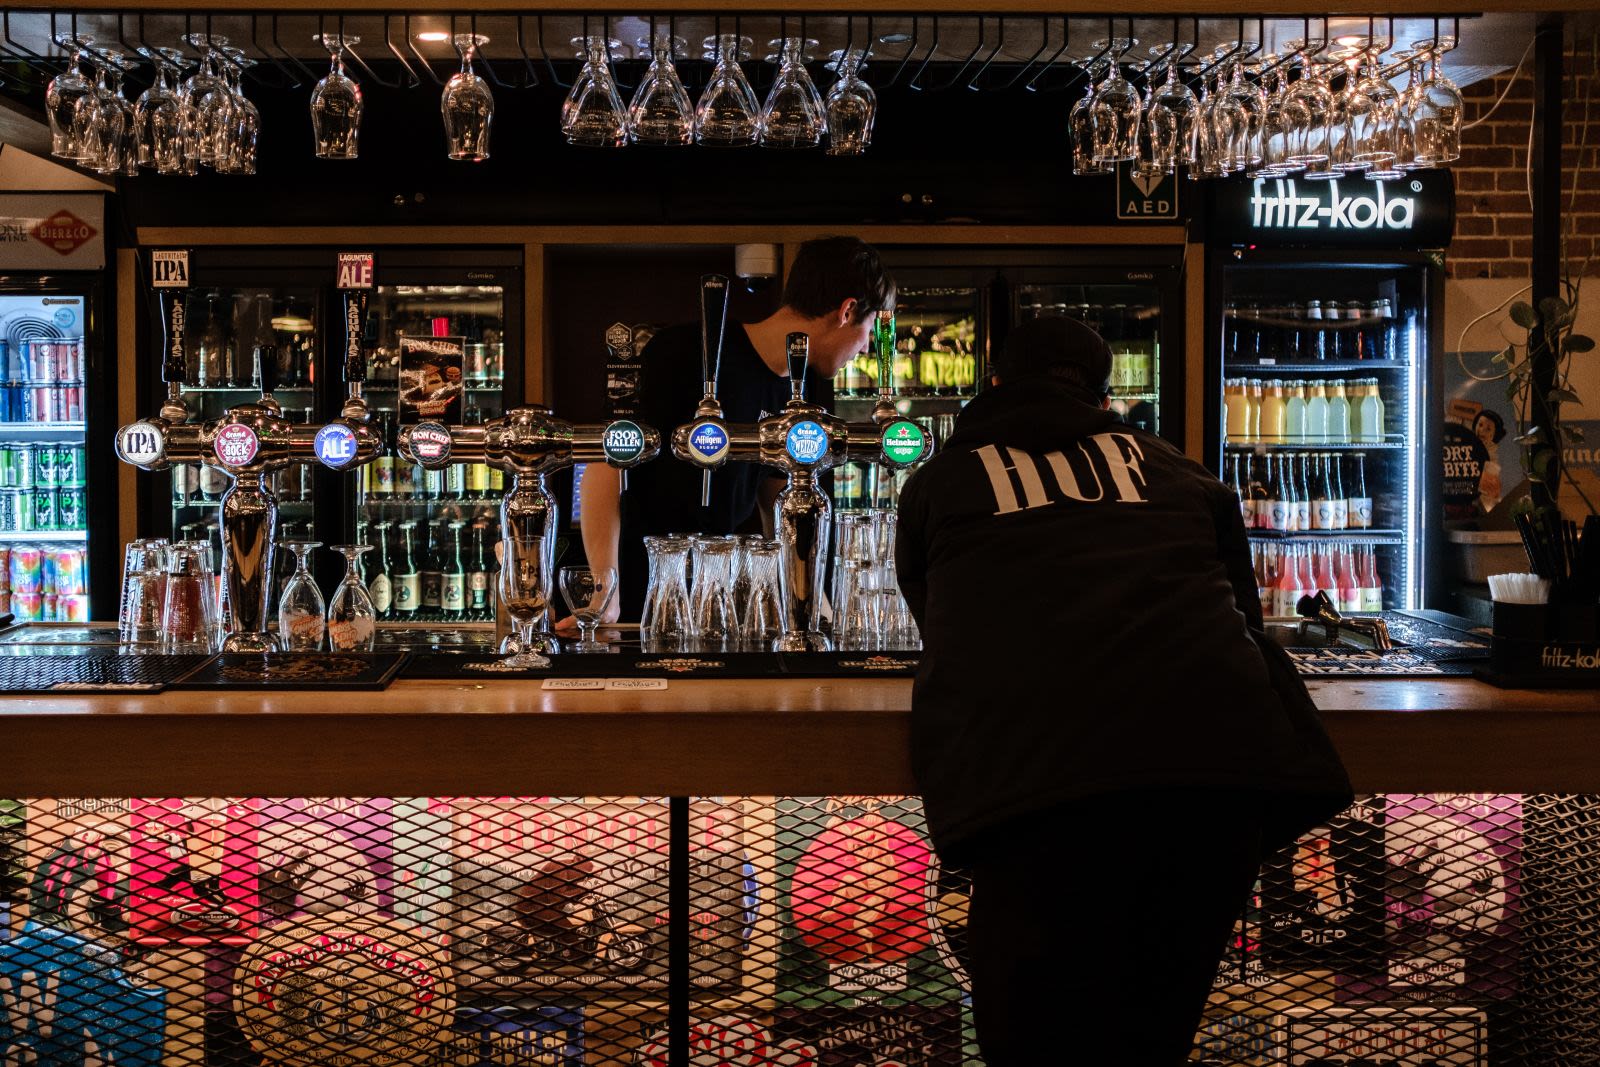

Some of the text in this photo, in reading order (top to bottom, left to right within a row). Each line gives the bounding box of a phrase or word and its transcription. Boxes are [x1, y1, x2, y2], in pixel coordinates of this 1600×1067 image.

[1126, 201, 1170, 214] AED
[1251, 178, 1415, 229] fritz-kola
[155, 260, 187, 281] IPA
[339, 265, 372, 287] ALE
[172, 299, 183, 358] LAGUNITAS
[348, 300, 359, 357] LAGUNITAS
[226, 430, 246, 439] Brand
[413, 431, 450, 443] BON CHEF
[609, 430, 637, 440] FOOD
[797, 428, 818, 436] Brand
[127, 433, 157, 453] IPA
[607, 438, 641, 447] HALLEN
[695, 435, 722, 445] Affligem
[795, 440, 819, 453] WEIZEN
[886, 438, 920, 447] Heineken
[225, 443, 248, 457] BOCK
[322, 440, 351, 459] ALE
[970, 433, 1149, 515] HUF
[1444, 461, 1480, 478] BITE
